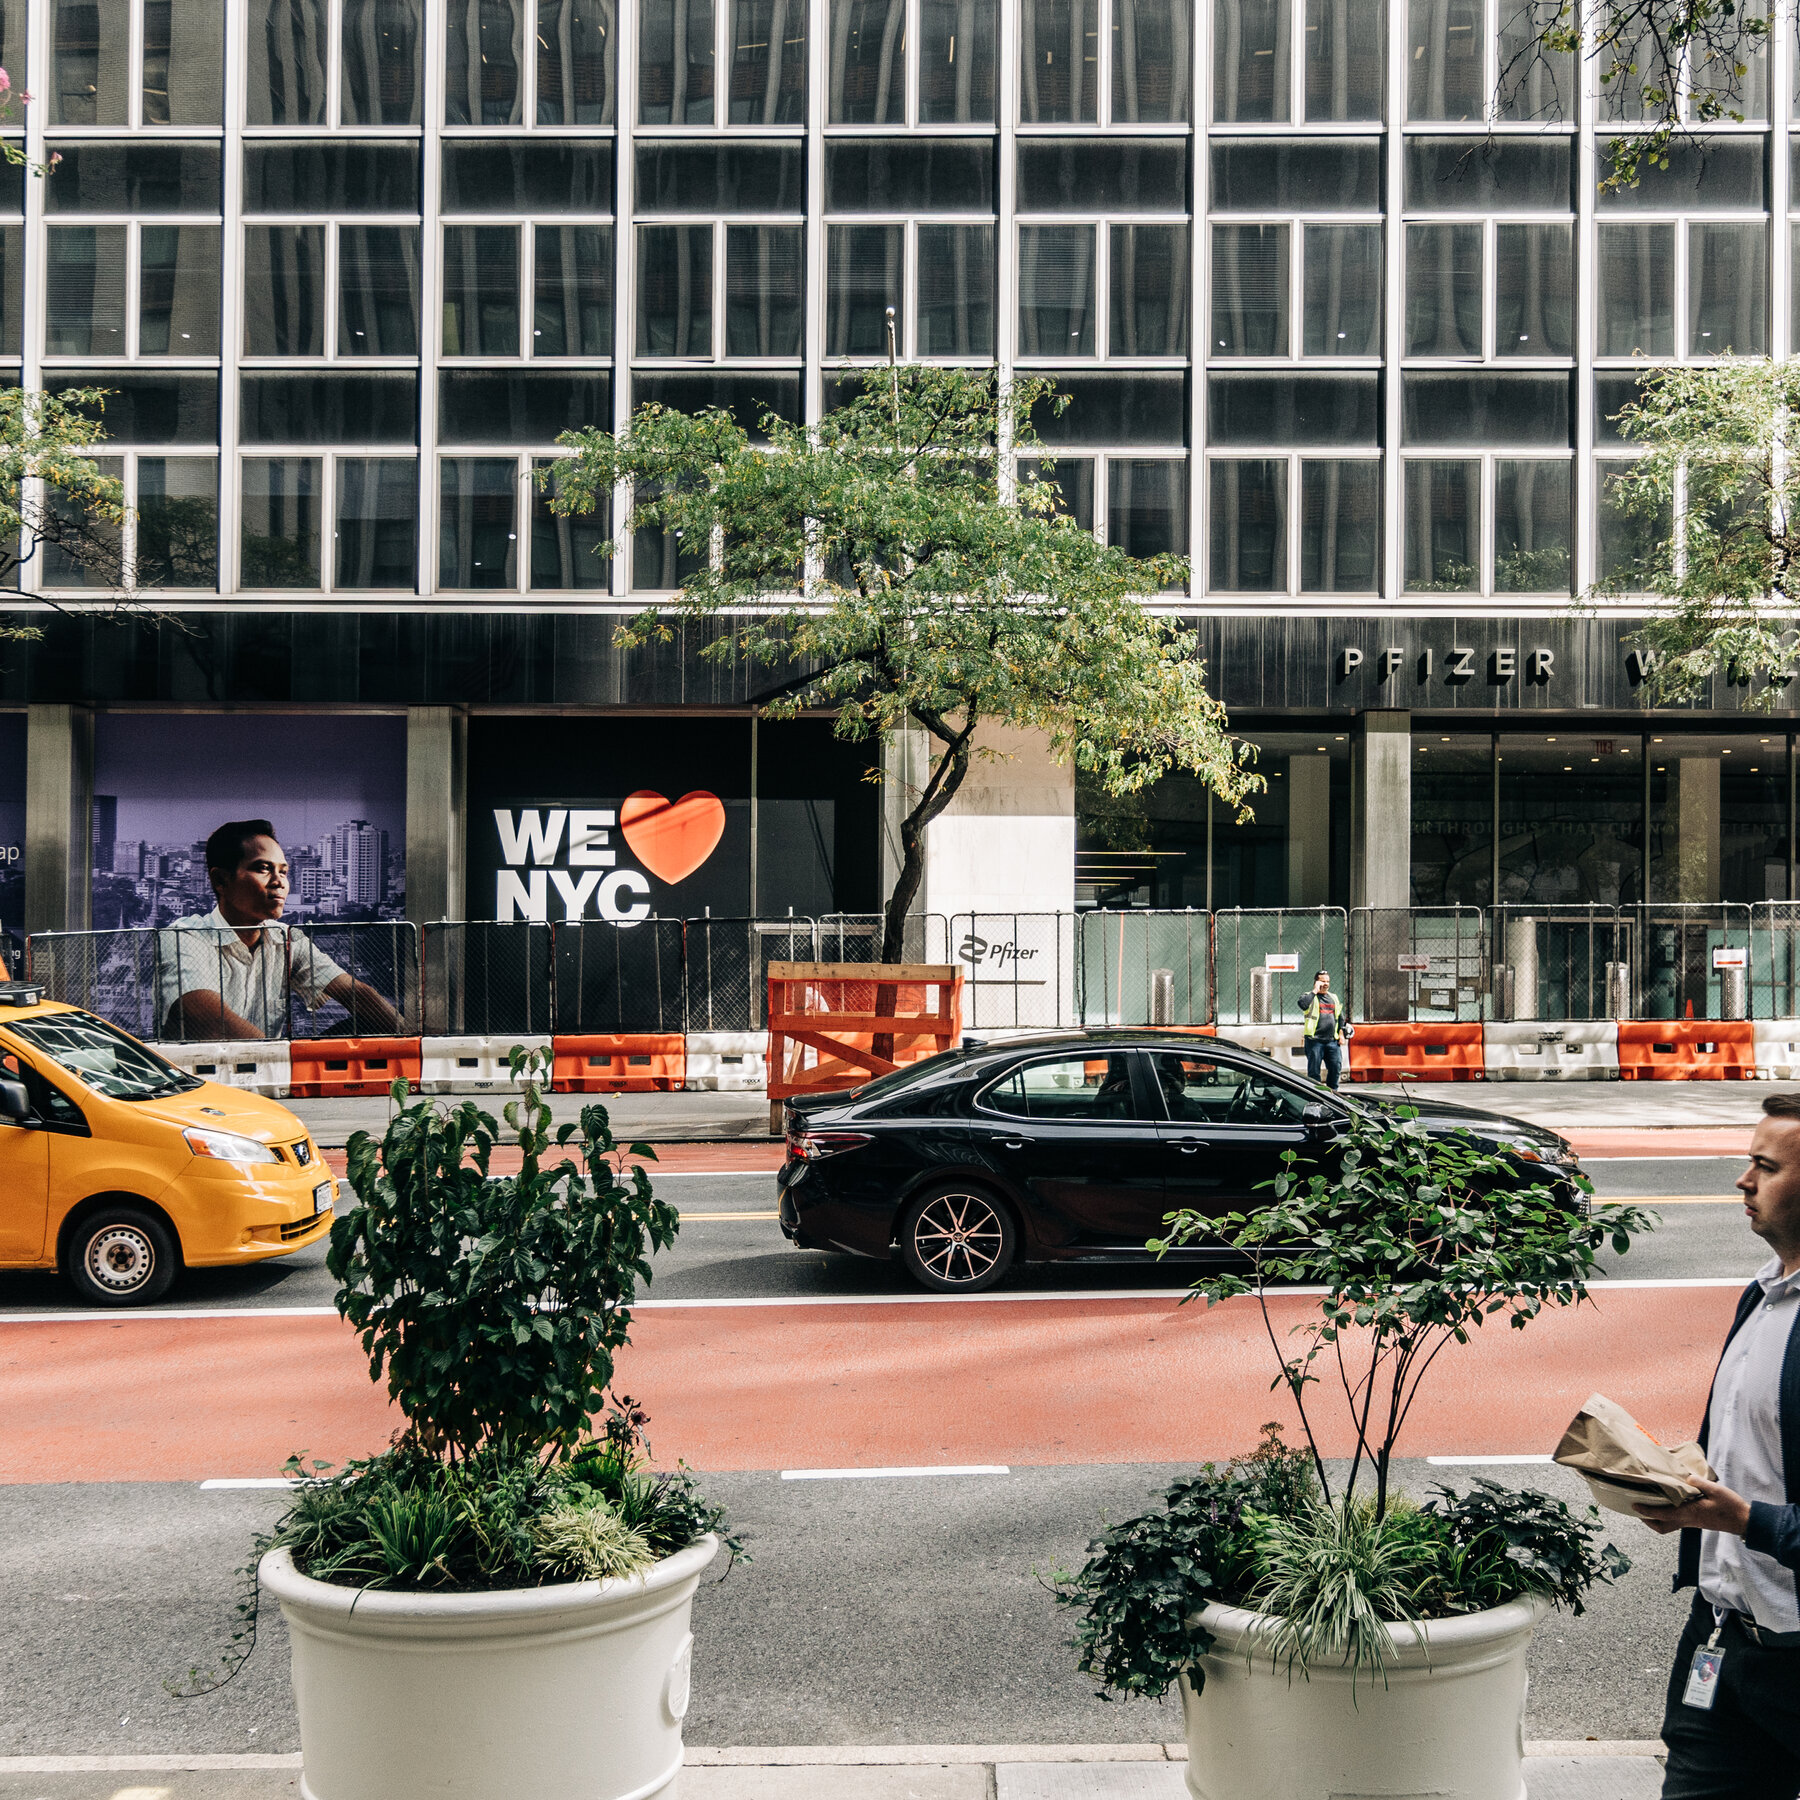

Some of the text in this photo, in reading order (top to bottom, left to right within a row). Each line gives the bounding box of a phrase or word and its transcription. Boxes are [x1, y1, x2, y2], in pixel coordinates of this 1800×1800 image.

[1344, 648, 1555, 676] PFIZER
[493, 809, 616, 866] WE
[496, 869, 651, 928] NYC
[989, 941, 1039, 968] Pfizer
